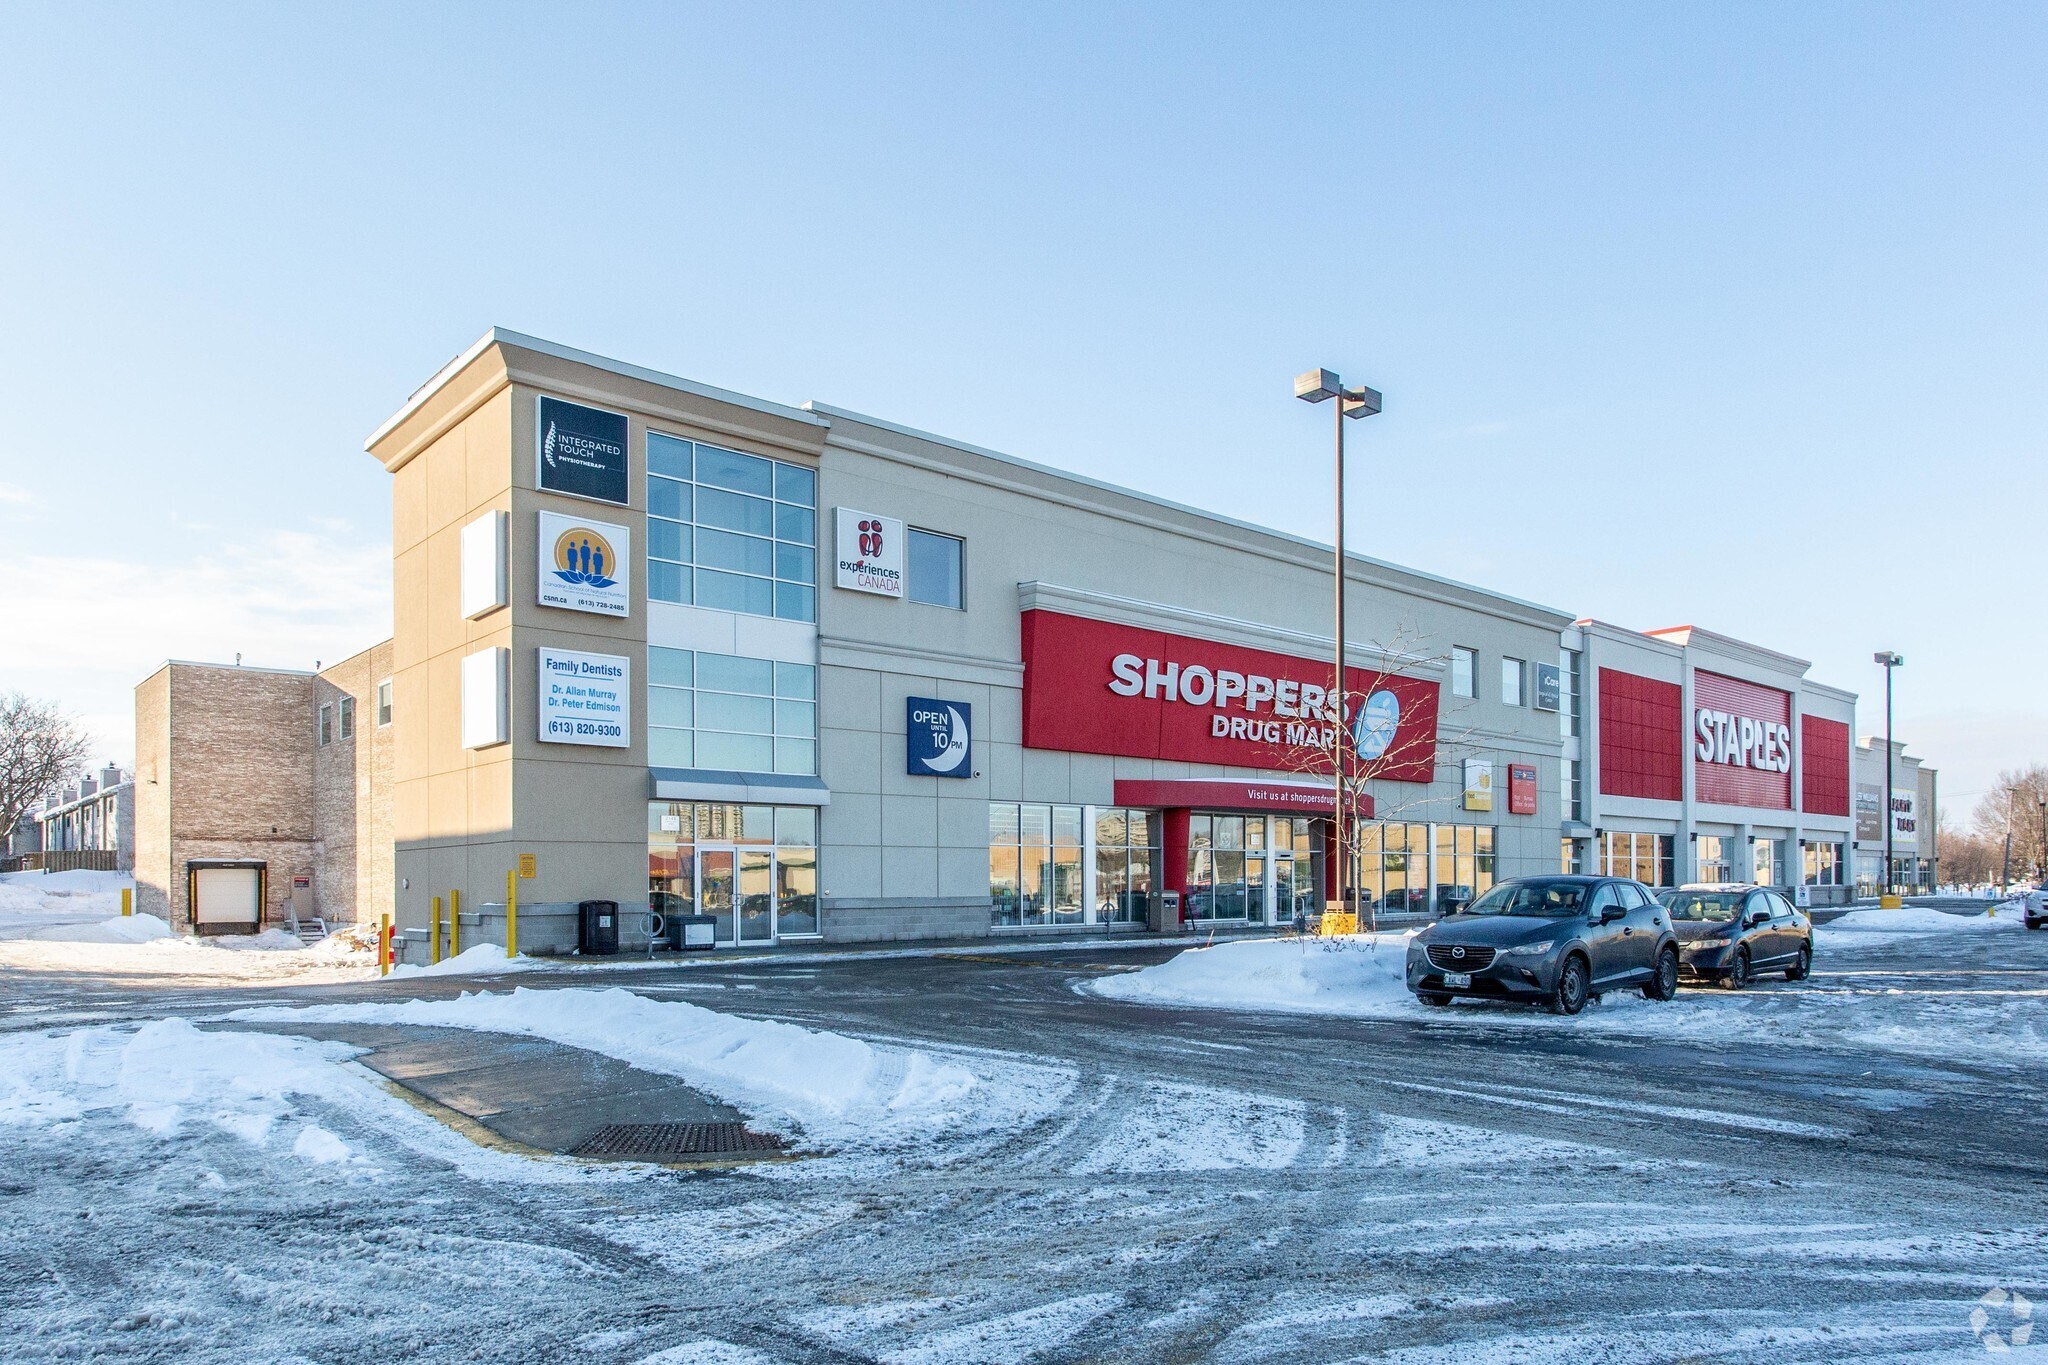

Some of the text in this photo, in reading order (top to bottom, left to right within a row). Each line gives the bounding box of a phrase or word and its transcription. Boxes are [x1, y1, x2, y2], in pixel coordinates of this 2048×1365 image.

[558, 434, 621, 455] INTEGRATED
[559, 443, 594, 459] TOUCH
[558, 455, 606, 470] PHYSIOTHERAPY
[840, 560, 900, 580] experiences
[857, 573, 901, 593] CANADA
[543, 594, 568, 604] csnn.ca
[578, 598, 595, 608] (613)
[596, 601, 625, 611] 728-2485
[546, 657, 623, 677] Family Dentists
[552, 684, 617, 701] Dr. Allan Murray
[1108, 653, 1350, 724] SHOPPERS
[548, 697, 621, 713] Dr. Peter Edmison
[913, 710, 948, 725] OPEN
[548, 721, 621, 737] (613) 820-9300
[930, 724, 948, 732] UNTIL
[1211, 714, 1348, 751] DRUG MAR
[932, 731, 963, 750] 10 PM
[1695, 707, 1791, 774] STAPLES
[1247, 789, 1268, 800] Visit
[1269, 792, 1279, 801] us
[1280, 792, 1289, 801] at
